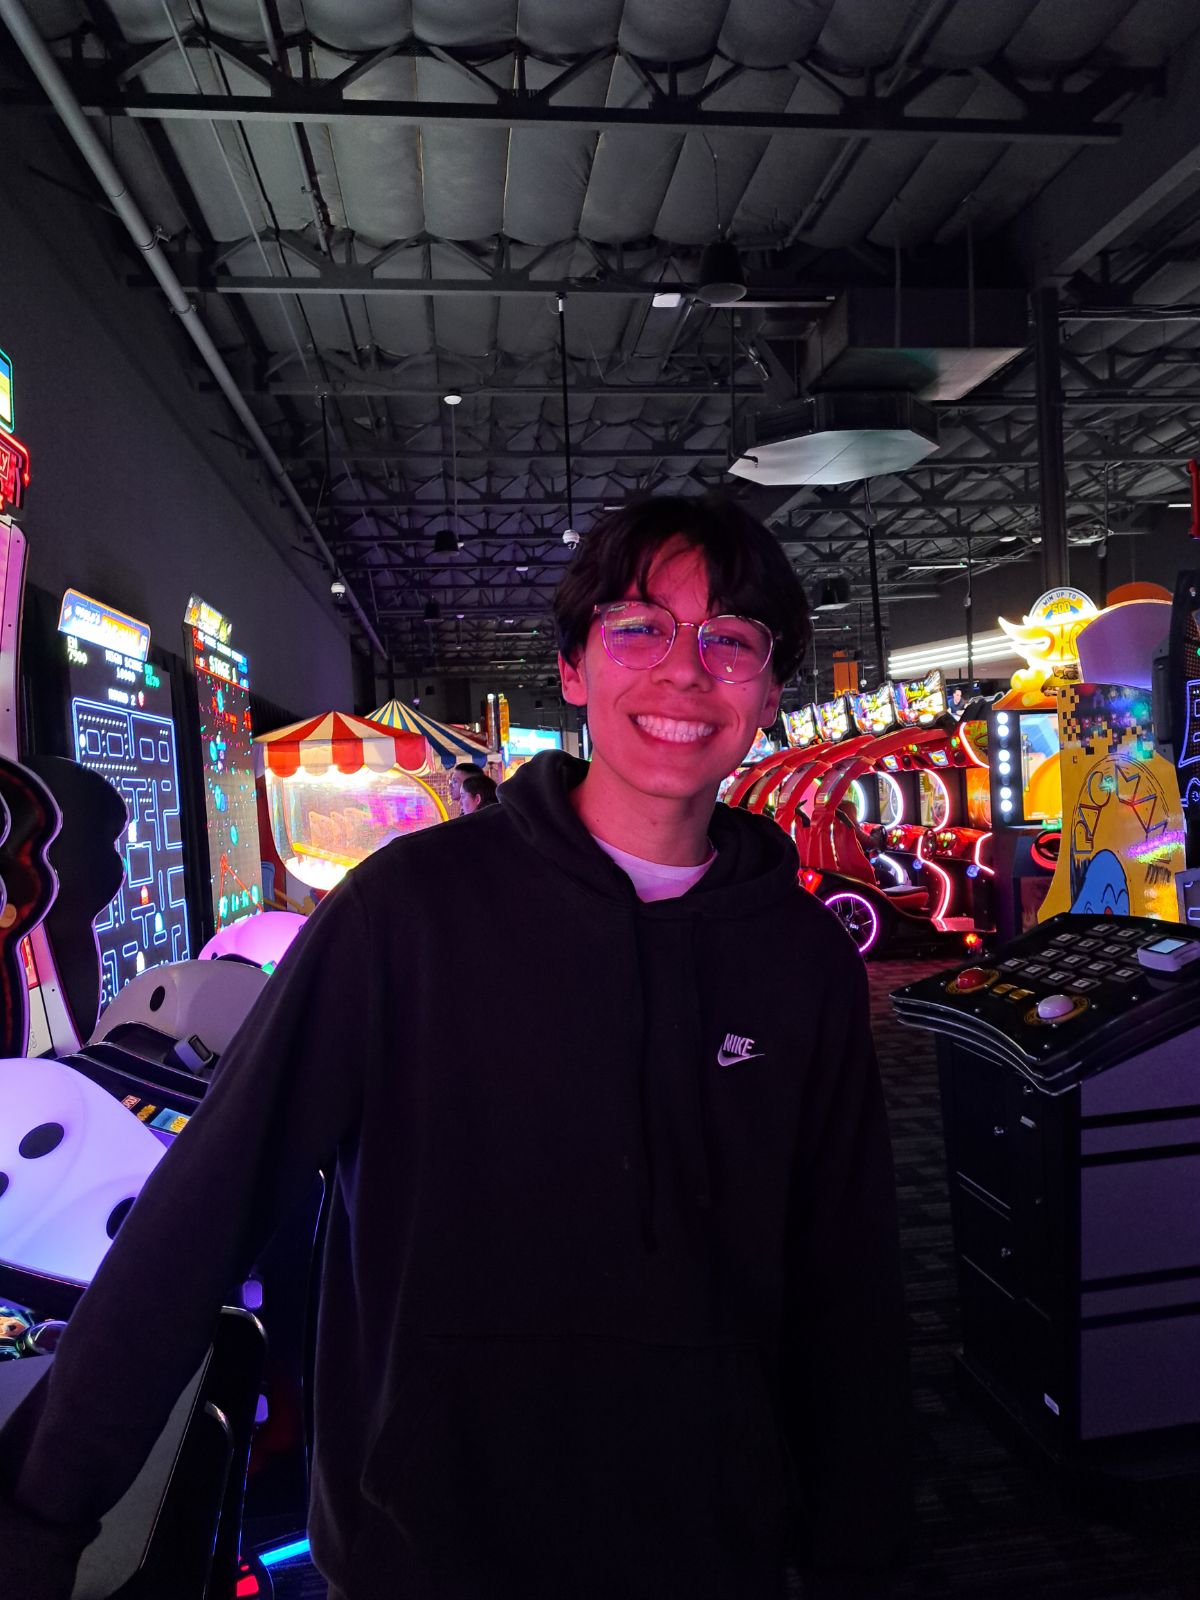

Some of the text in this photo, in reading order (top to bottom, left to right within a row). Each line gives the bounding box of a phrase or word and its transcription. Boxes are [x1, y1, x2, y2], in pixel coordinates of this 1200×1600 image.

[1042, 595, 1054, 605] WIN
[1068, 592, 1077, 600] TO
[208, 655, 231, 680] STAGE
[232, 667, 238, 684] 1
[130, 694, 137, 706] 2
[723, 1033, 755, 1056] NIKE
